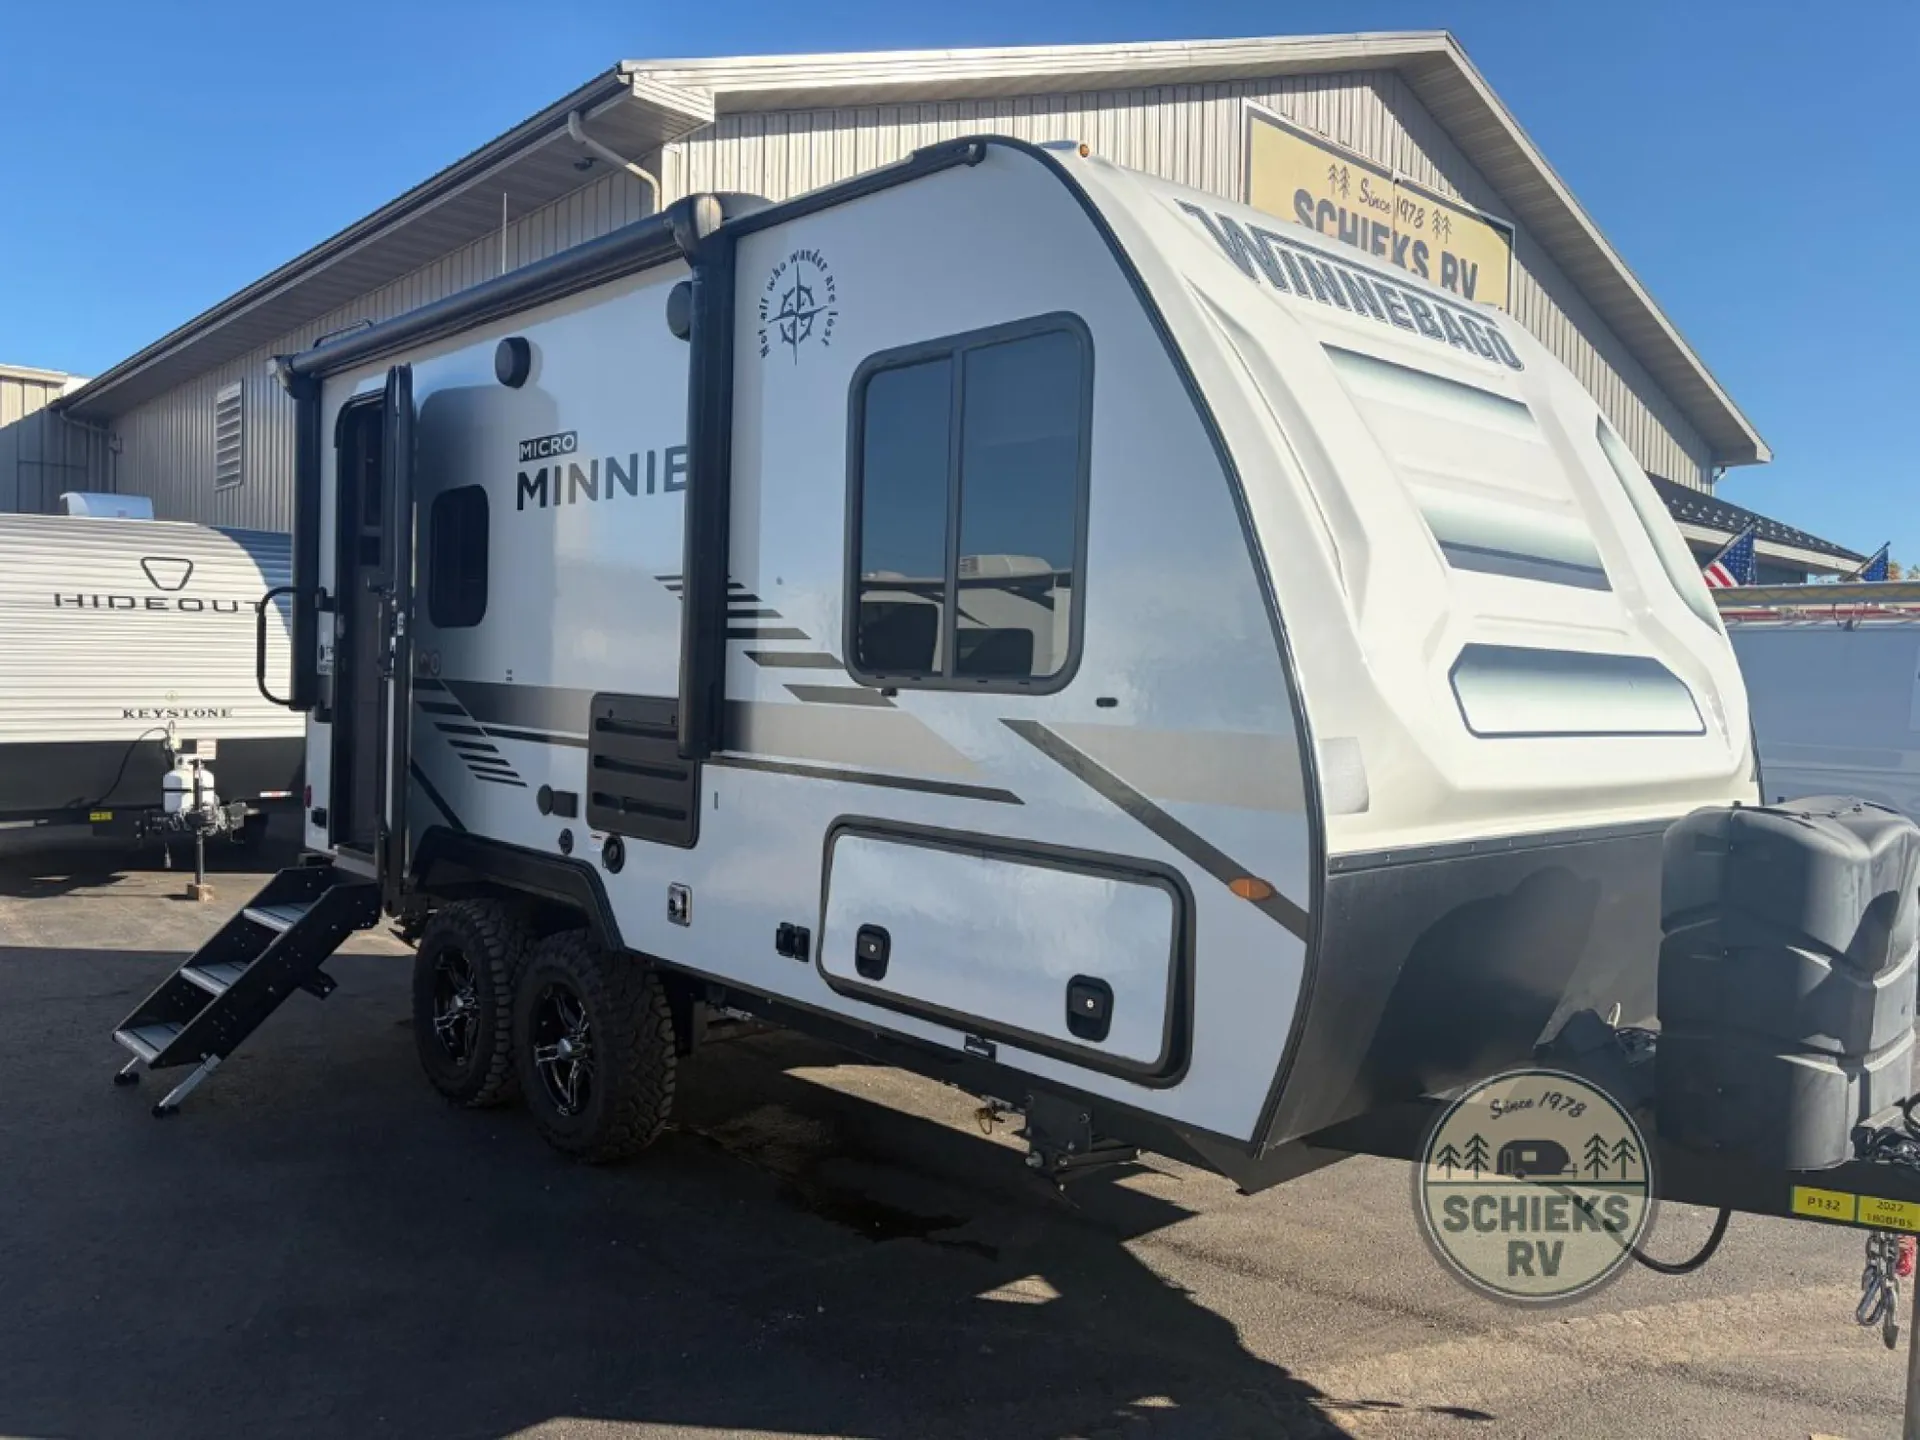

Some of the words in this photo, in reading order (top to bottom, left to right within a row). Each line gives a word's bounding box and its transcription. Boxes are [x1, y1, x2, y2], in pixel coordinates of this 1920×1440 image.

[1358, 177, 1391, 215] Since
[1395, 195, 1426, 230] 1978
[1173, 197, 1526, 371] WINNEBAGO
[1441, 250, 1478, 301] RV
[519, 434, 576, 461] MICRO
[516, 444, 688, 511] MINNIE
[122, 707, 233, 719] KEYSTONE
[1807, 1195, 1841, 1212] P132
